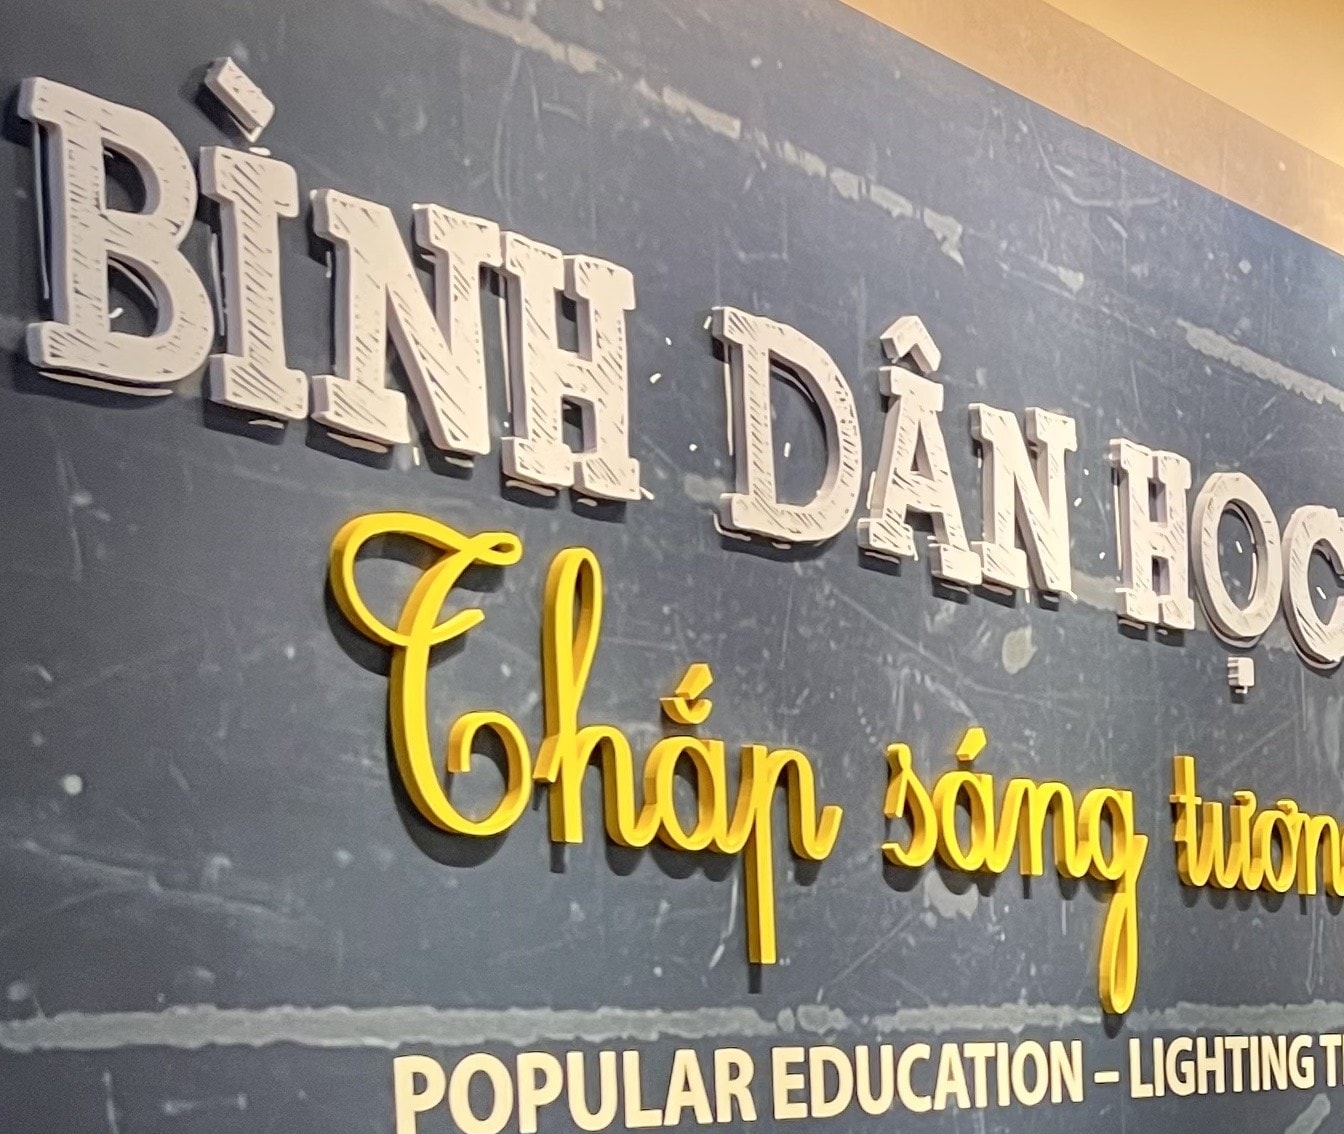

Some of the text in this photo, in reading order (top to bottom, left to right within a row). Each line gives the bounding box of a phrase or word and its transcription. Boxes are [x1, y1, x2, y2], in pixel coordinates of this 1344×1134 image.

[18, 56, 642, 502] BÌNH
[713, 304, 1078, 600] DÂN
[331, 511, 844, 965] Thắp
[880, 722, 1149, 1015] sáng
[771, 1040, 1084, 1120] EDUCATION
[1129, 1035, 1315, 1098] LIGHTING
